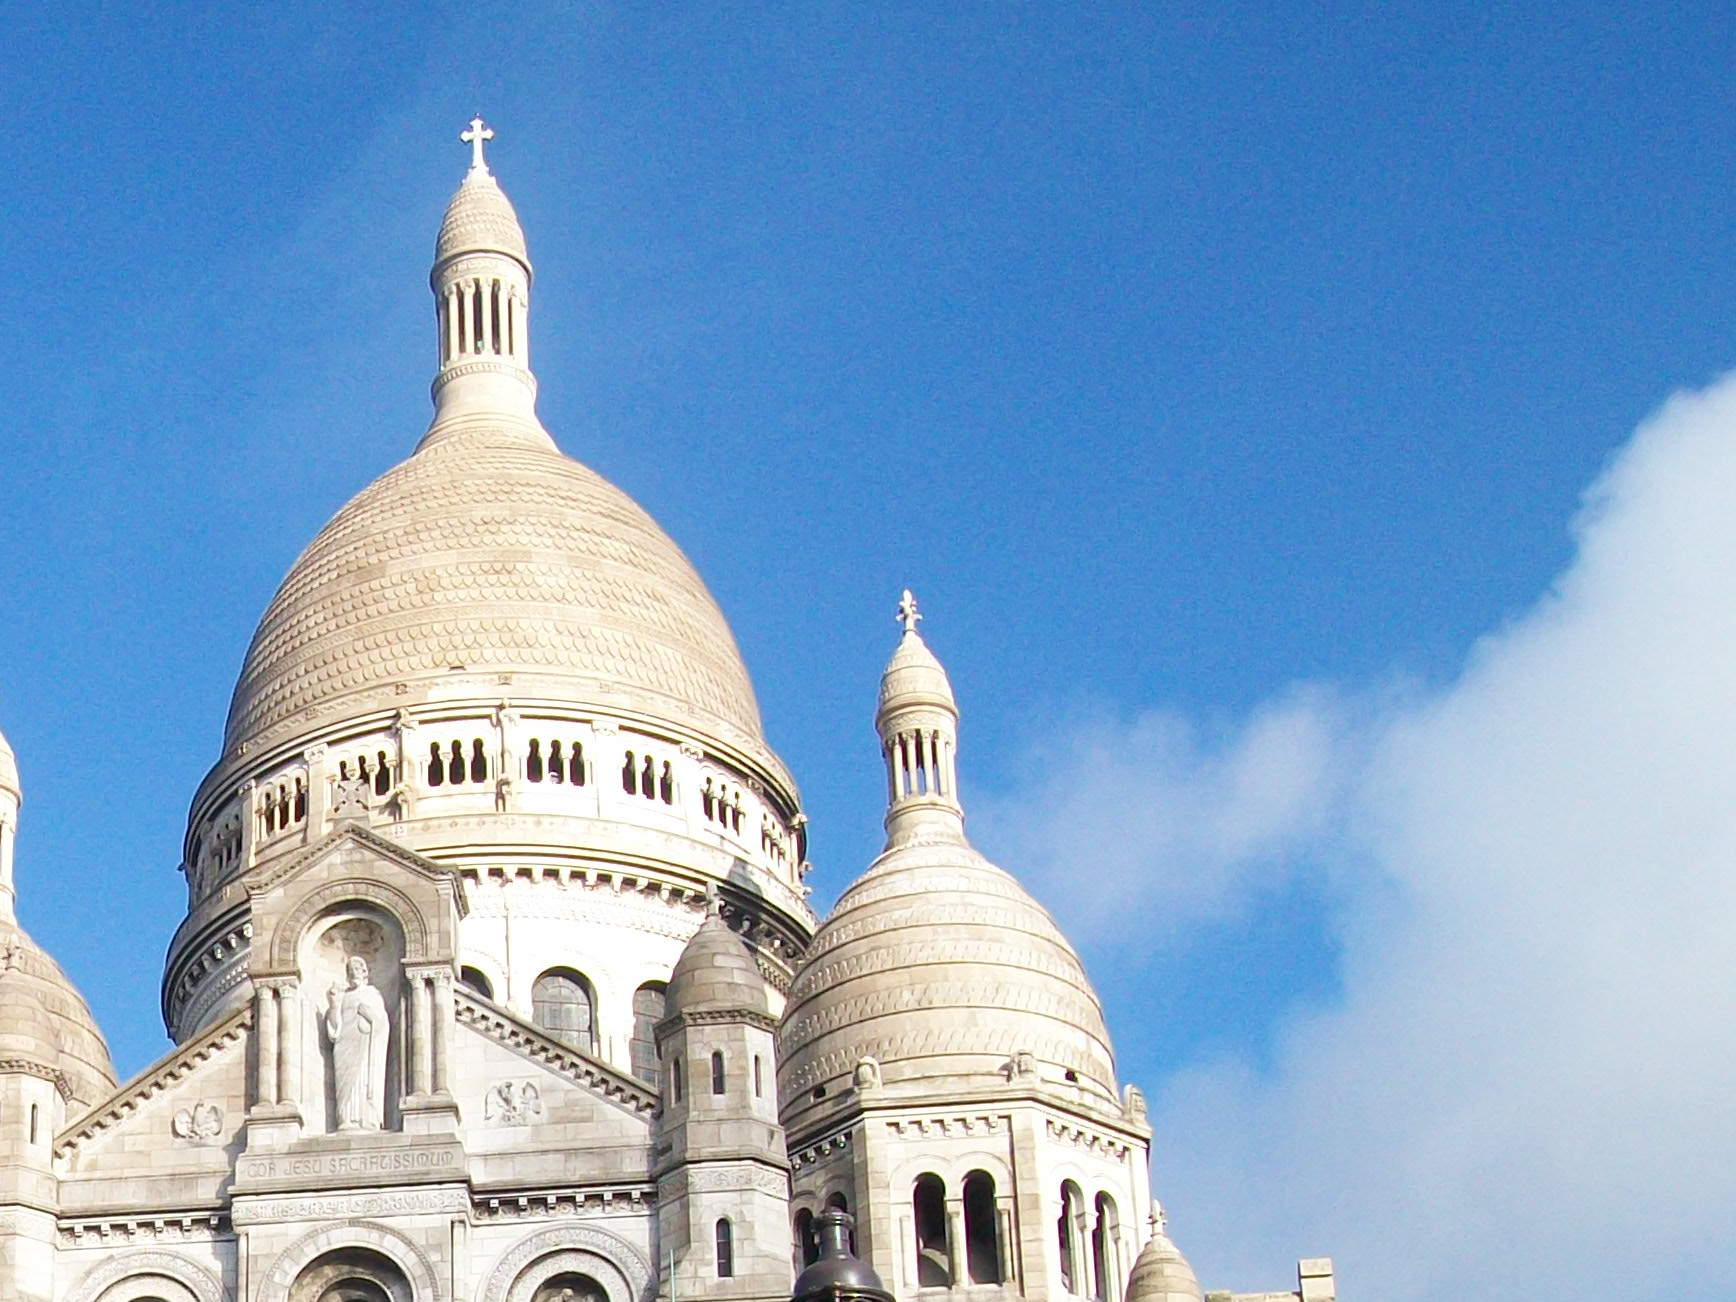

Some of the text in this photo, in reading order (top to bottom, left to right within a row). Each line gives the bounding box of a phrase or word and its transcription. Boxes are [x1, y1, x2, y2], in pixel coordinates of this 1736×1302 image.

[247, 1151, 454, 1178] COR JESU SACRATISSIMUM
